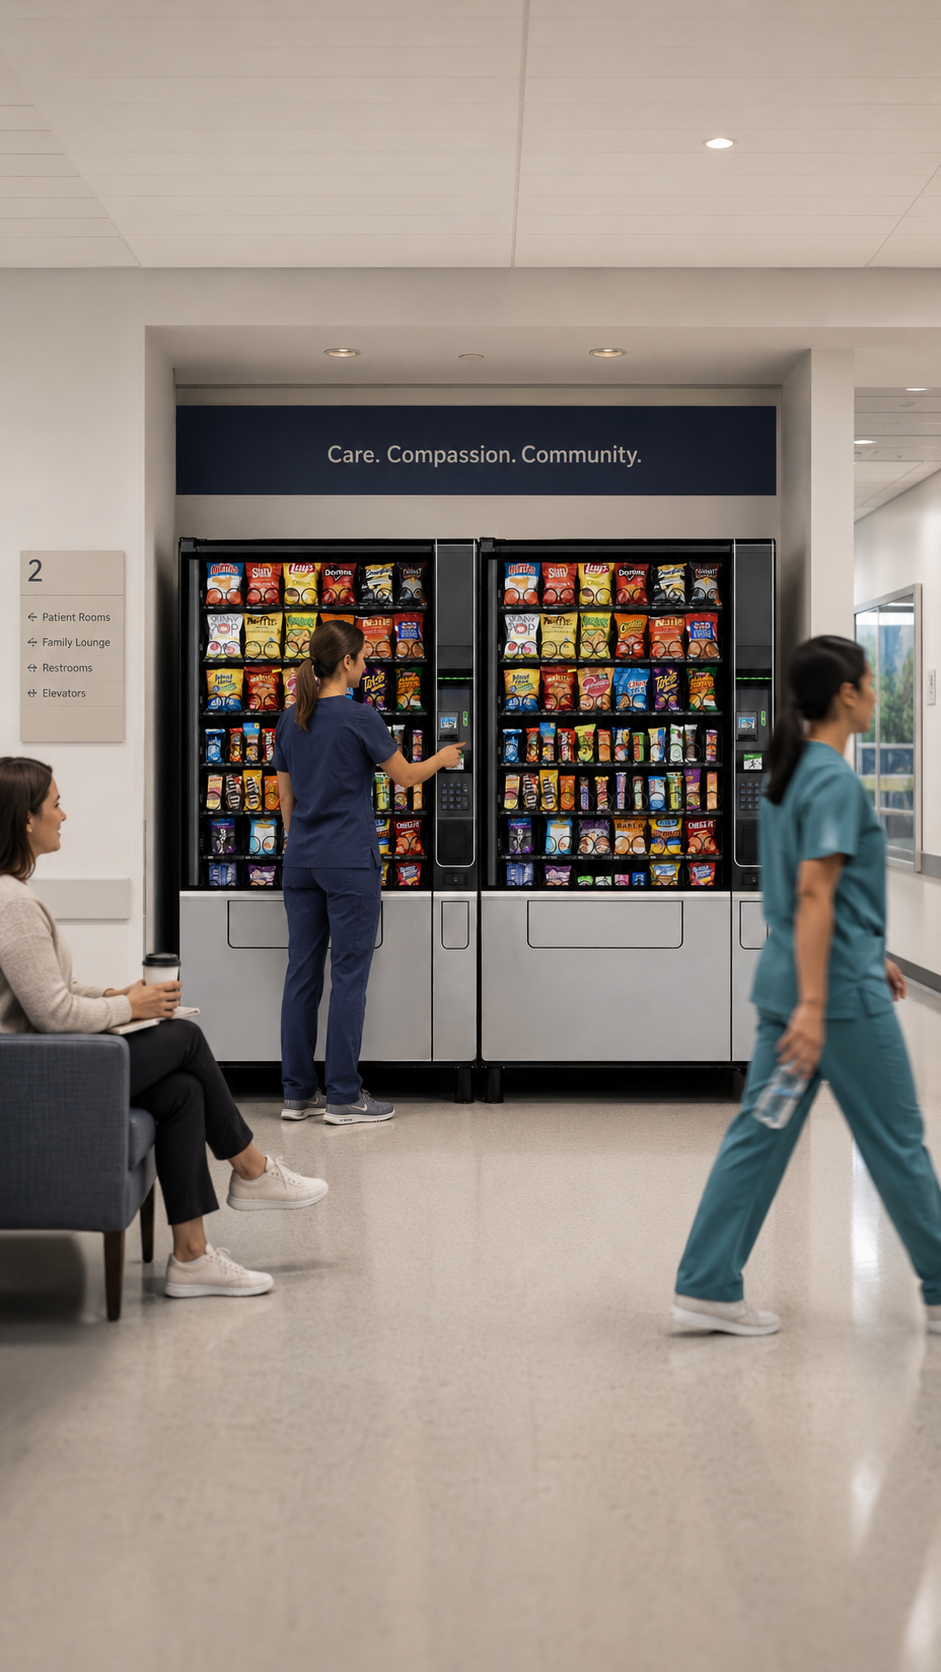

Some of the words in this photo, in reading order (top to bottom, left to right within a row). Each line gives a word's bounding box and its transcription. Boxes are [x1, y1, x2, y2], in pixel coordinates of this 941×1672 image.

[327, 444, 380, 464] Care.
[386, 444, 517, 468] Compassion.
[521, 444, 642, 468] Community.
[27, 558, 43, 583] 2
[42, 612, 76, 622] Patient
[78, 612, 111, 622] Rooms
[42, 637, 73, 649] Family
[75, 637, 111, 649] Lounge
[42, 663, 93, 673] Restrooms
[42, 688, 86, 698] Elevators
